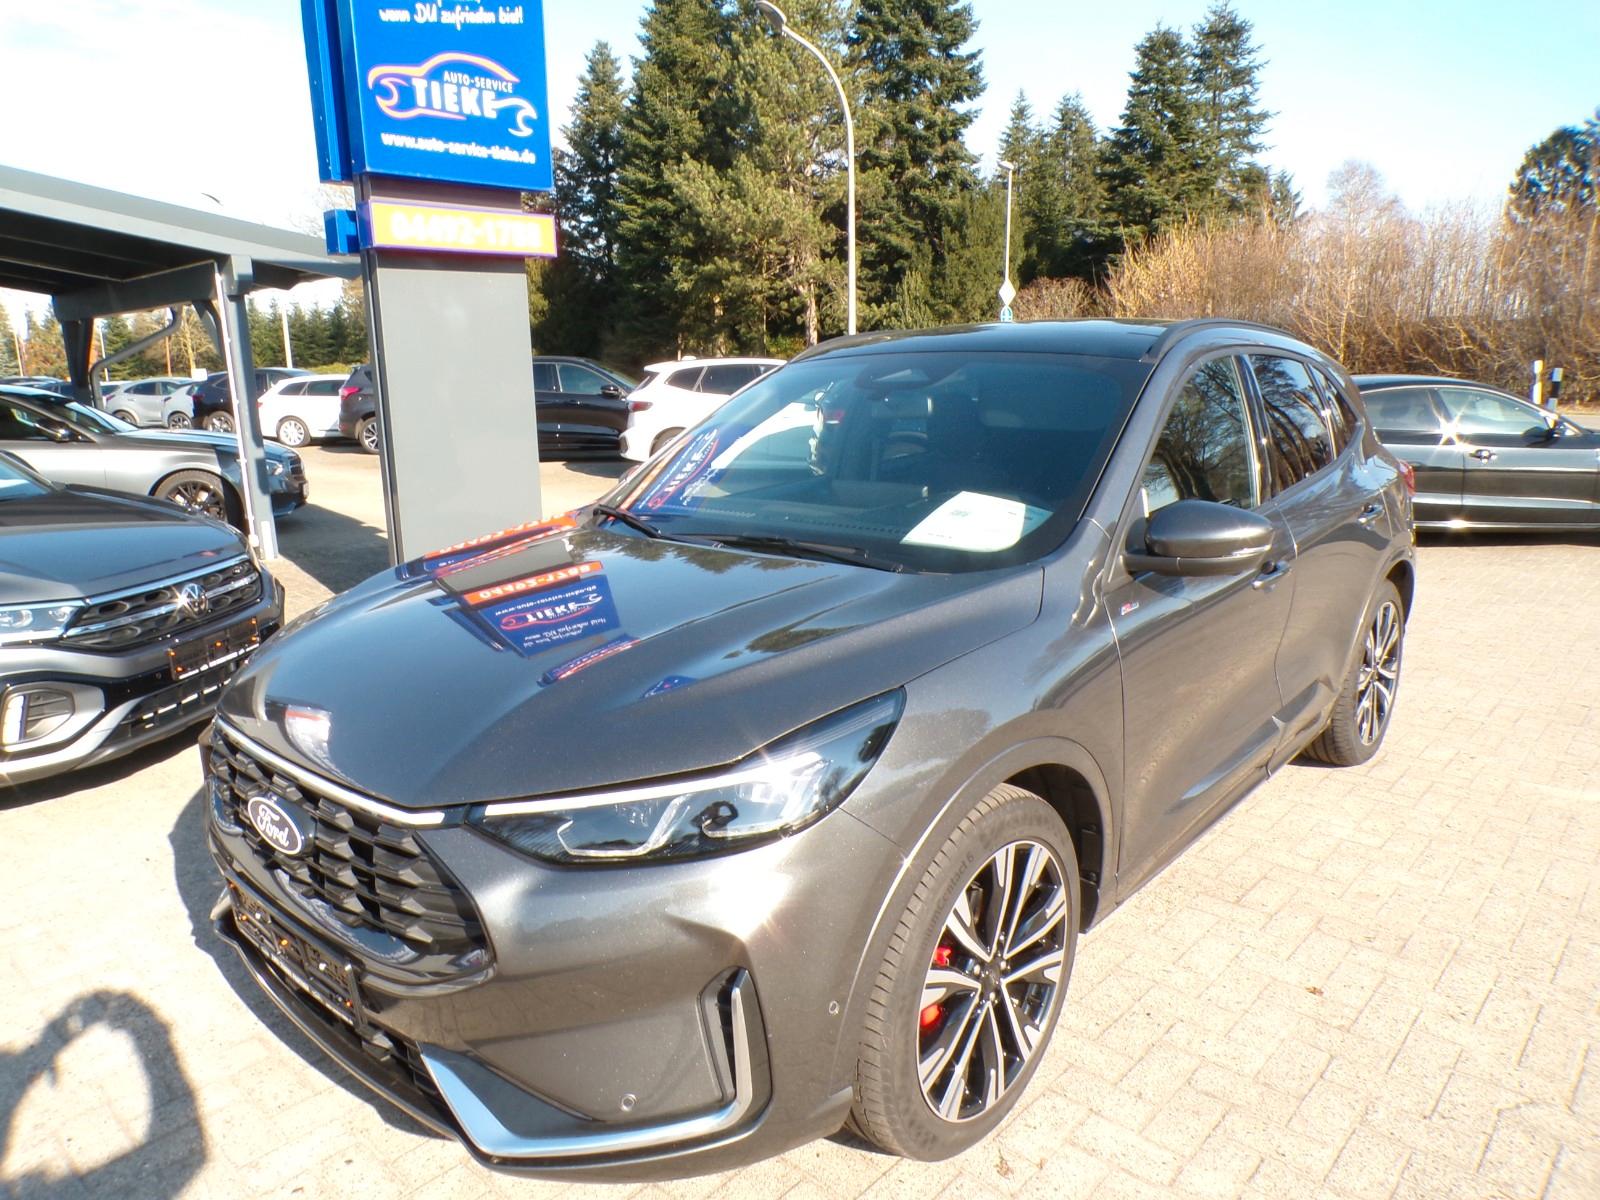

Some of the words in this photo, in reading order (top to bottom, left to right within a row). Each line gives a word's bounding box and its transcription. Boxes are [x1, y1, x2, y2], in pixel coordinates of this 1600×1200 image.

[414, 3, 438, 23] DU
[441, 5, 495, 31] zufrieden
[412, 77, 498, 119] TIEKE
[444, 70, 513, 94] AUTO-SERVICE
[381, 132, 536, 165] www.auto-service-tieke.de
[257, 804, 289, 847] Ford
